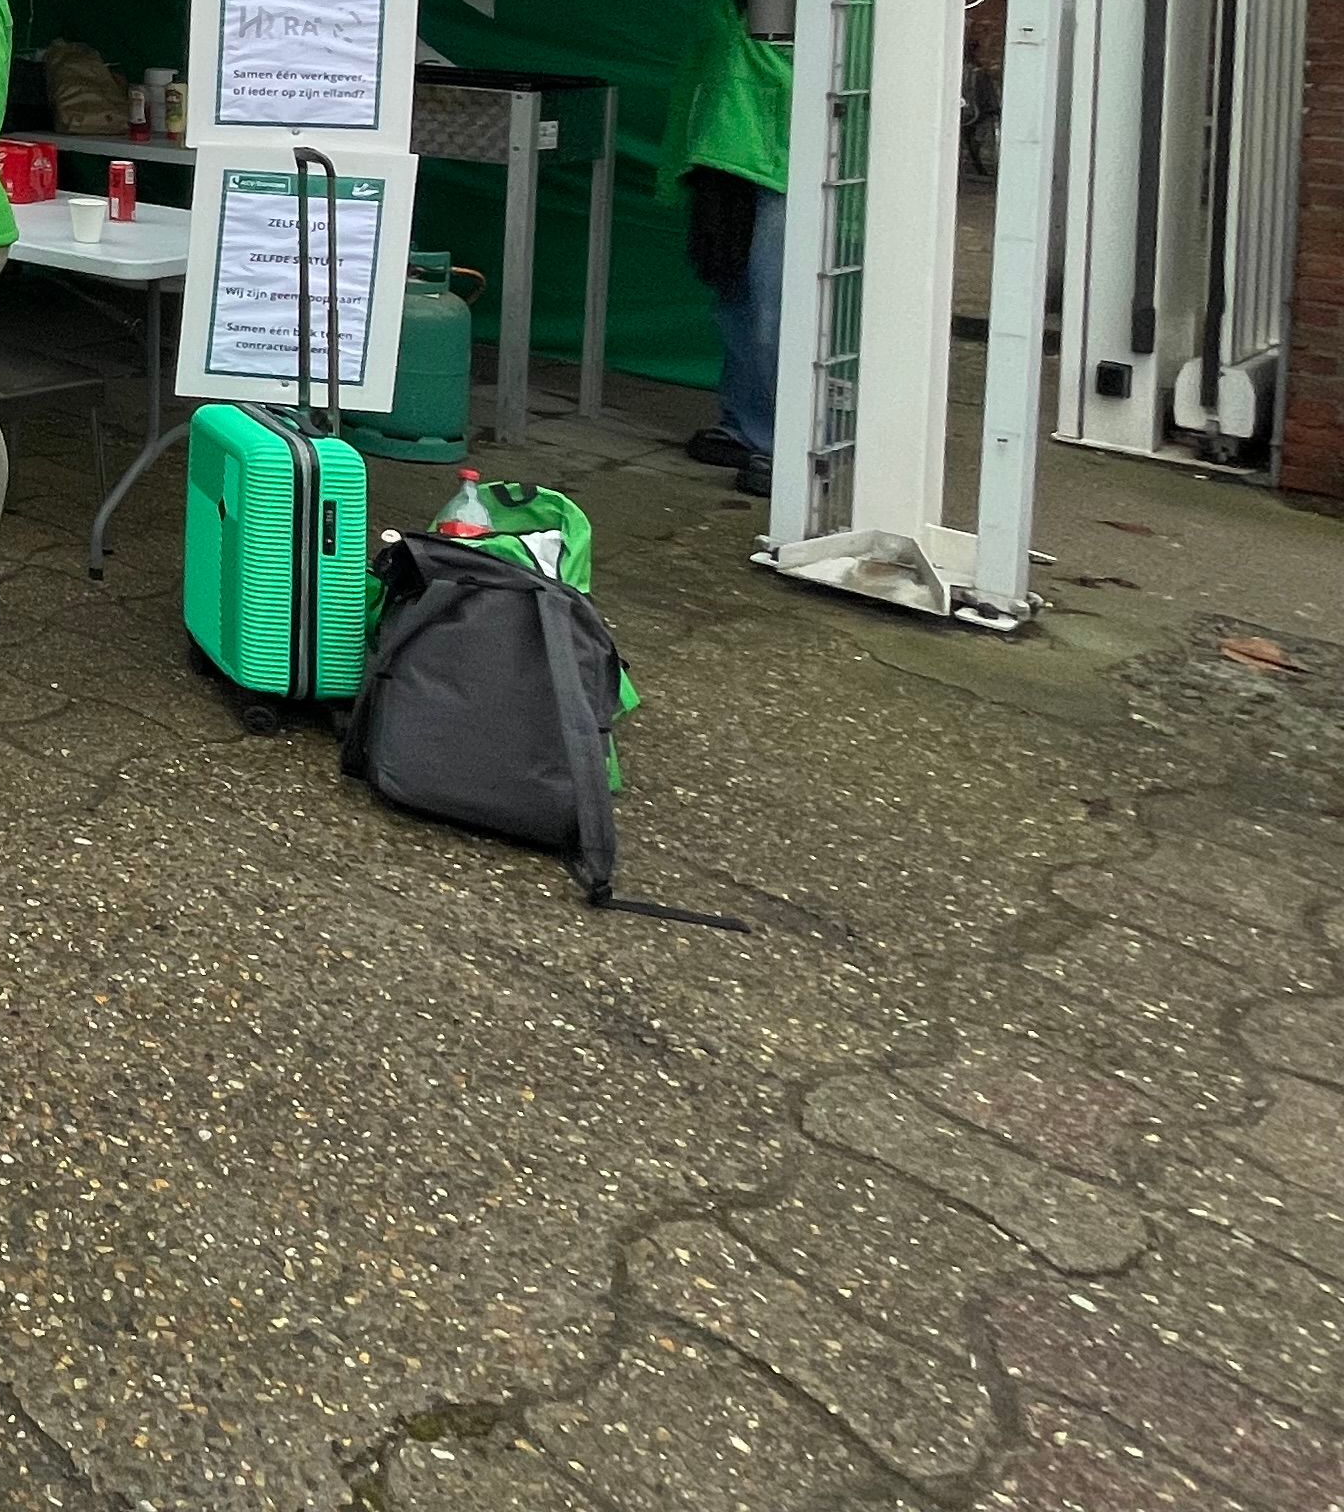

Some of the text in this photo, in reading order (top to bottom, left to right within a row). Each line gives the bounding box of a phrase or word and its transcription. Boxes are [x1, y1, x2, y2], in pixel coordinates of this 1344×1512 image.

[232, 69, 273, 80] Samen
[233, 86, 246, 96] of
[248, 87, 278, 97] ieder
[281, 89, 296, 99] op
[298, 88, 320, 100] zijn
[250, 253, 290, 264] ZELFDE
[225, 287, 244, 299] Wij
[246, 289, 268, 301] zijn
[227, 322, 266, 334] Samen
